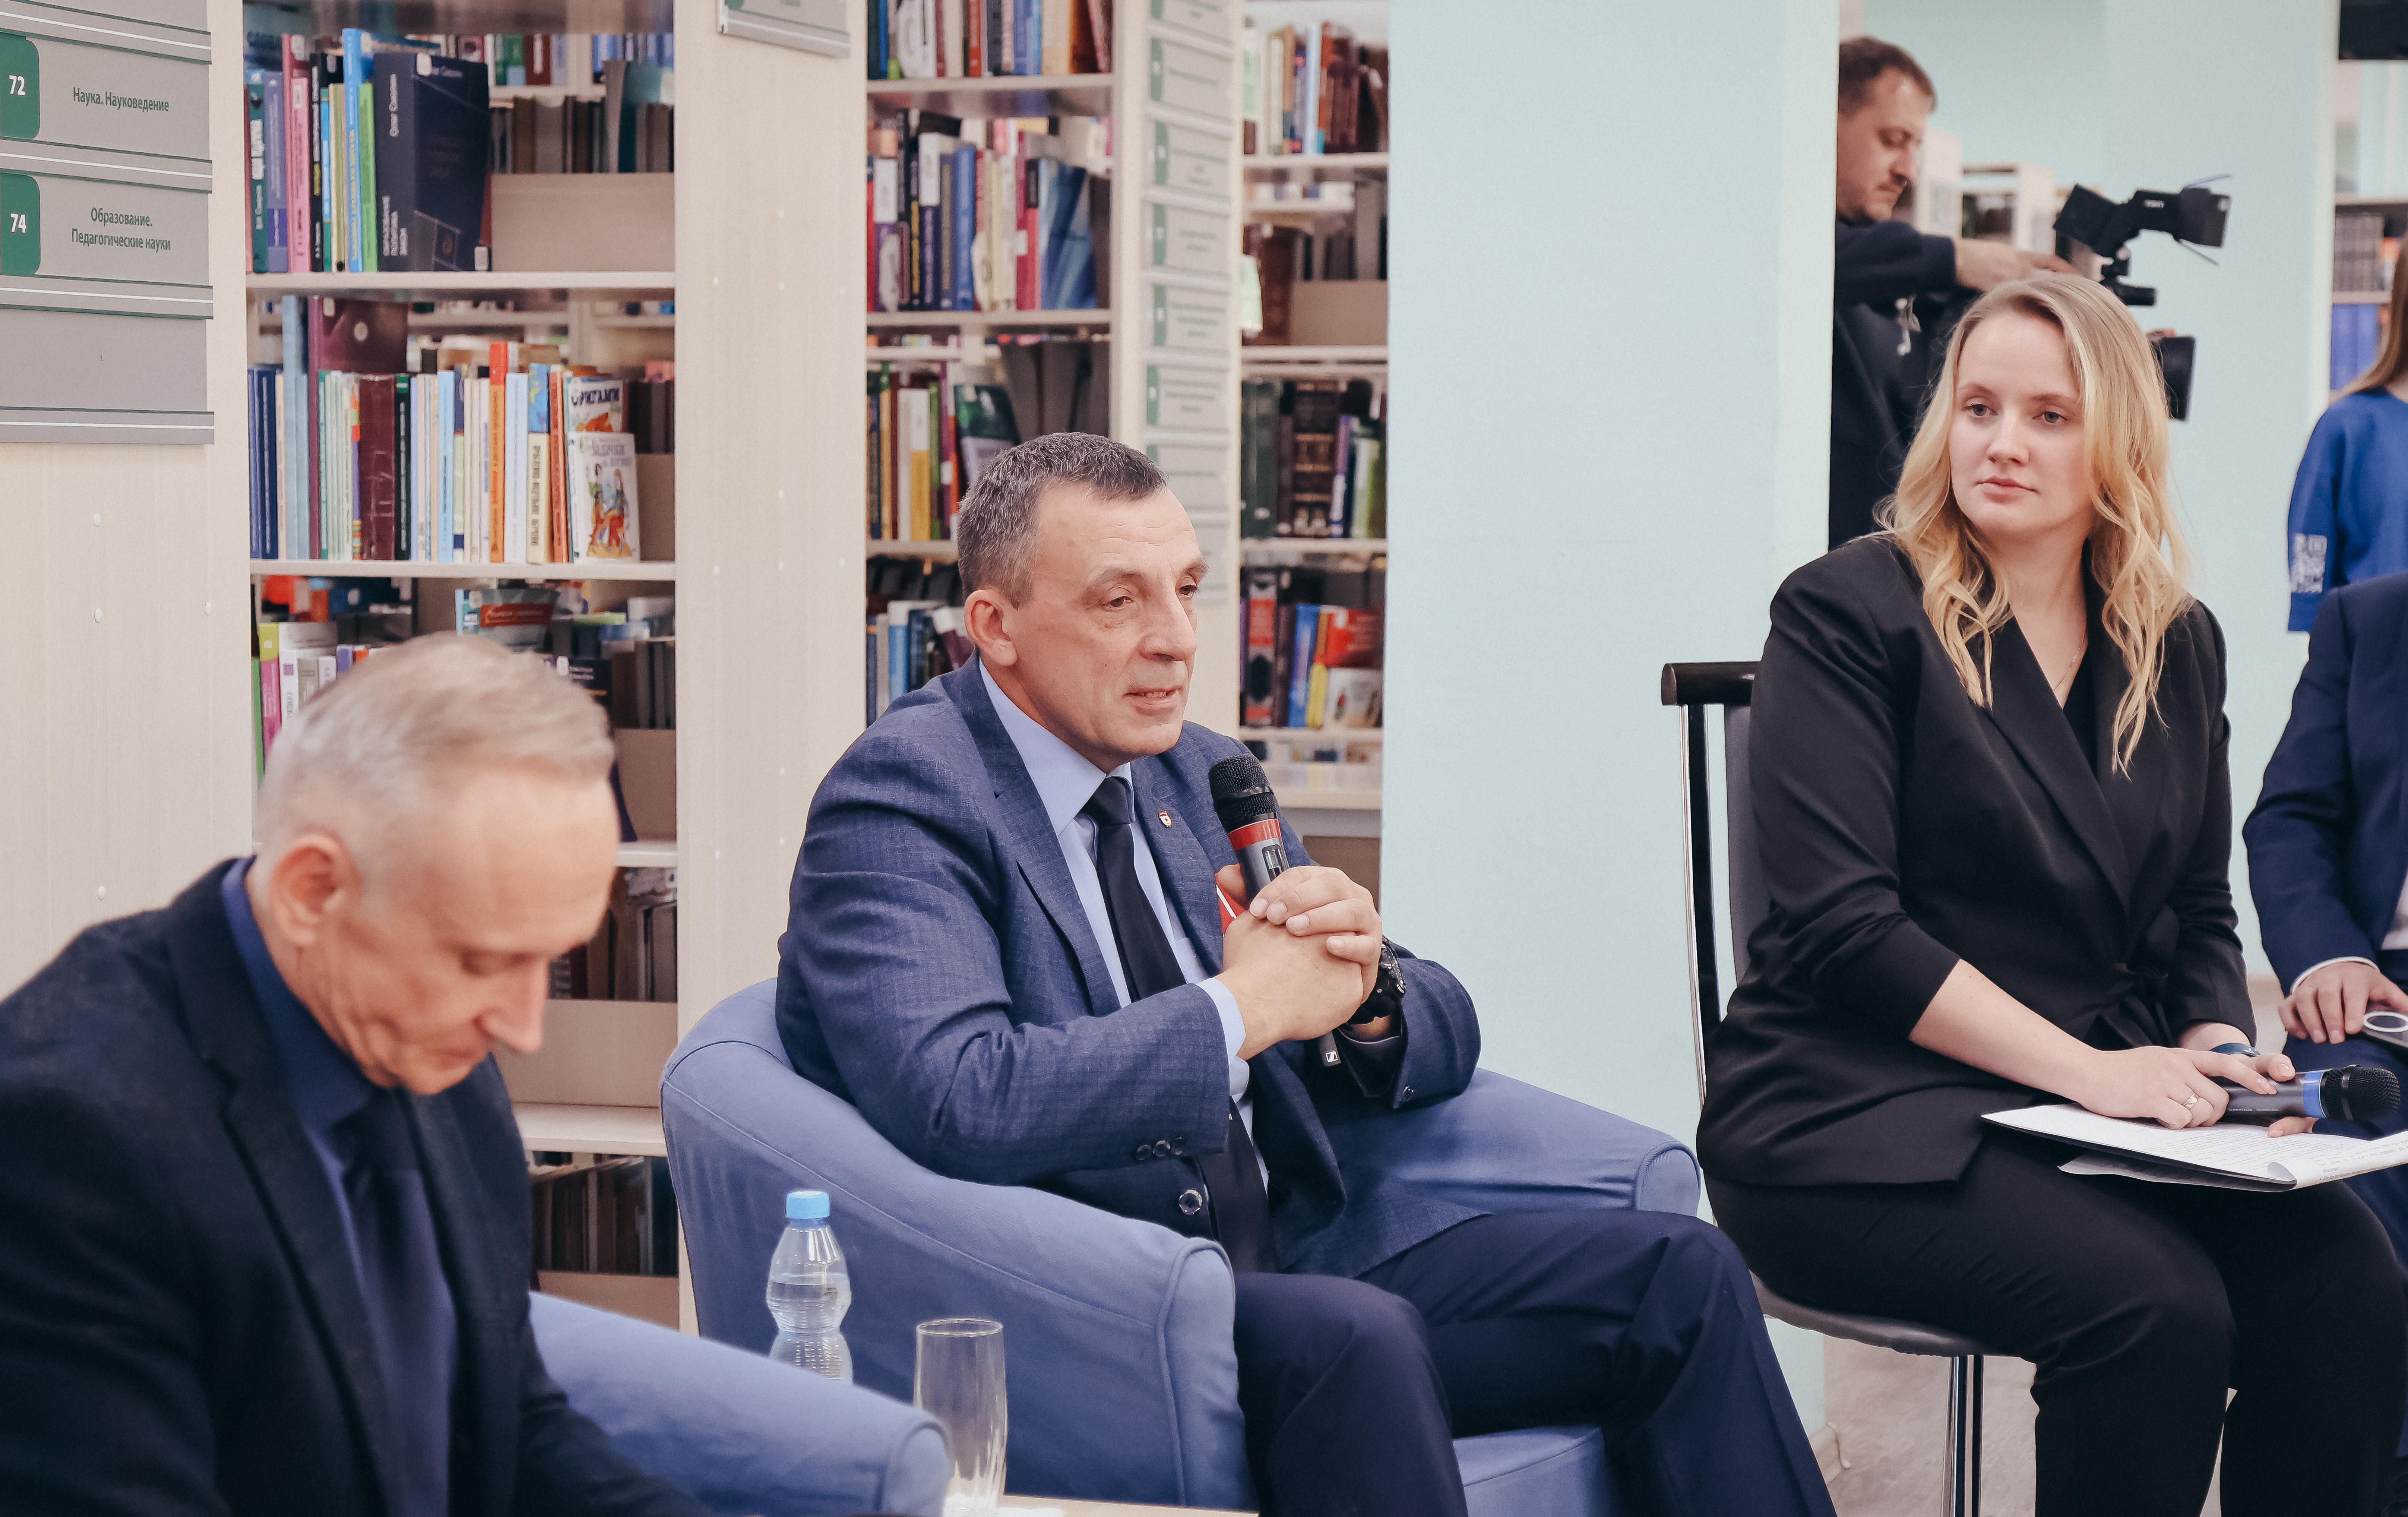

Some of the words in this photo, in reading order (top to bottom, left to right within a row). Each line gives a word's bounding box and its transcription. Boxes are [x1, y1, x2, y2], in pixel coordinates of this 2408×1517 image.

[9, 75, 25, 96] 72
[73, 87, 103, 107] Наука.
[105, 91, 169, 113] Науковедение
[10, 213, 26, 233] 74
[91, 207, 152, 227] Образование.
[71, 228, 143, 247] Педагогические
[145, 238, 171, 253] науки
